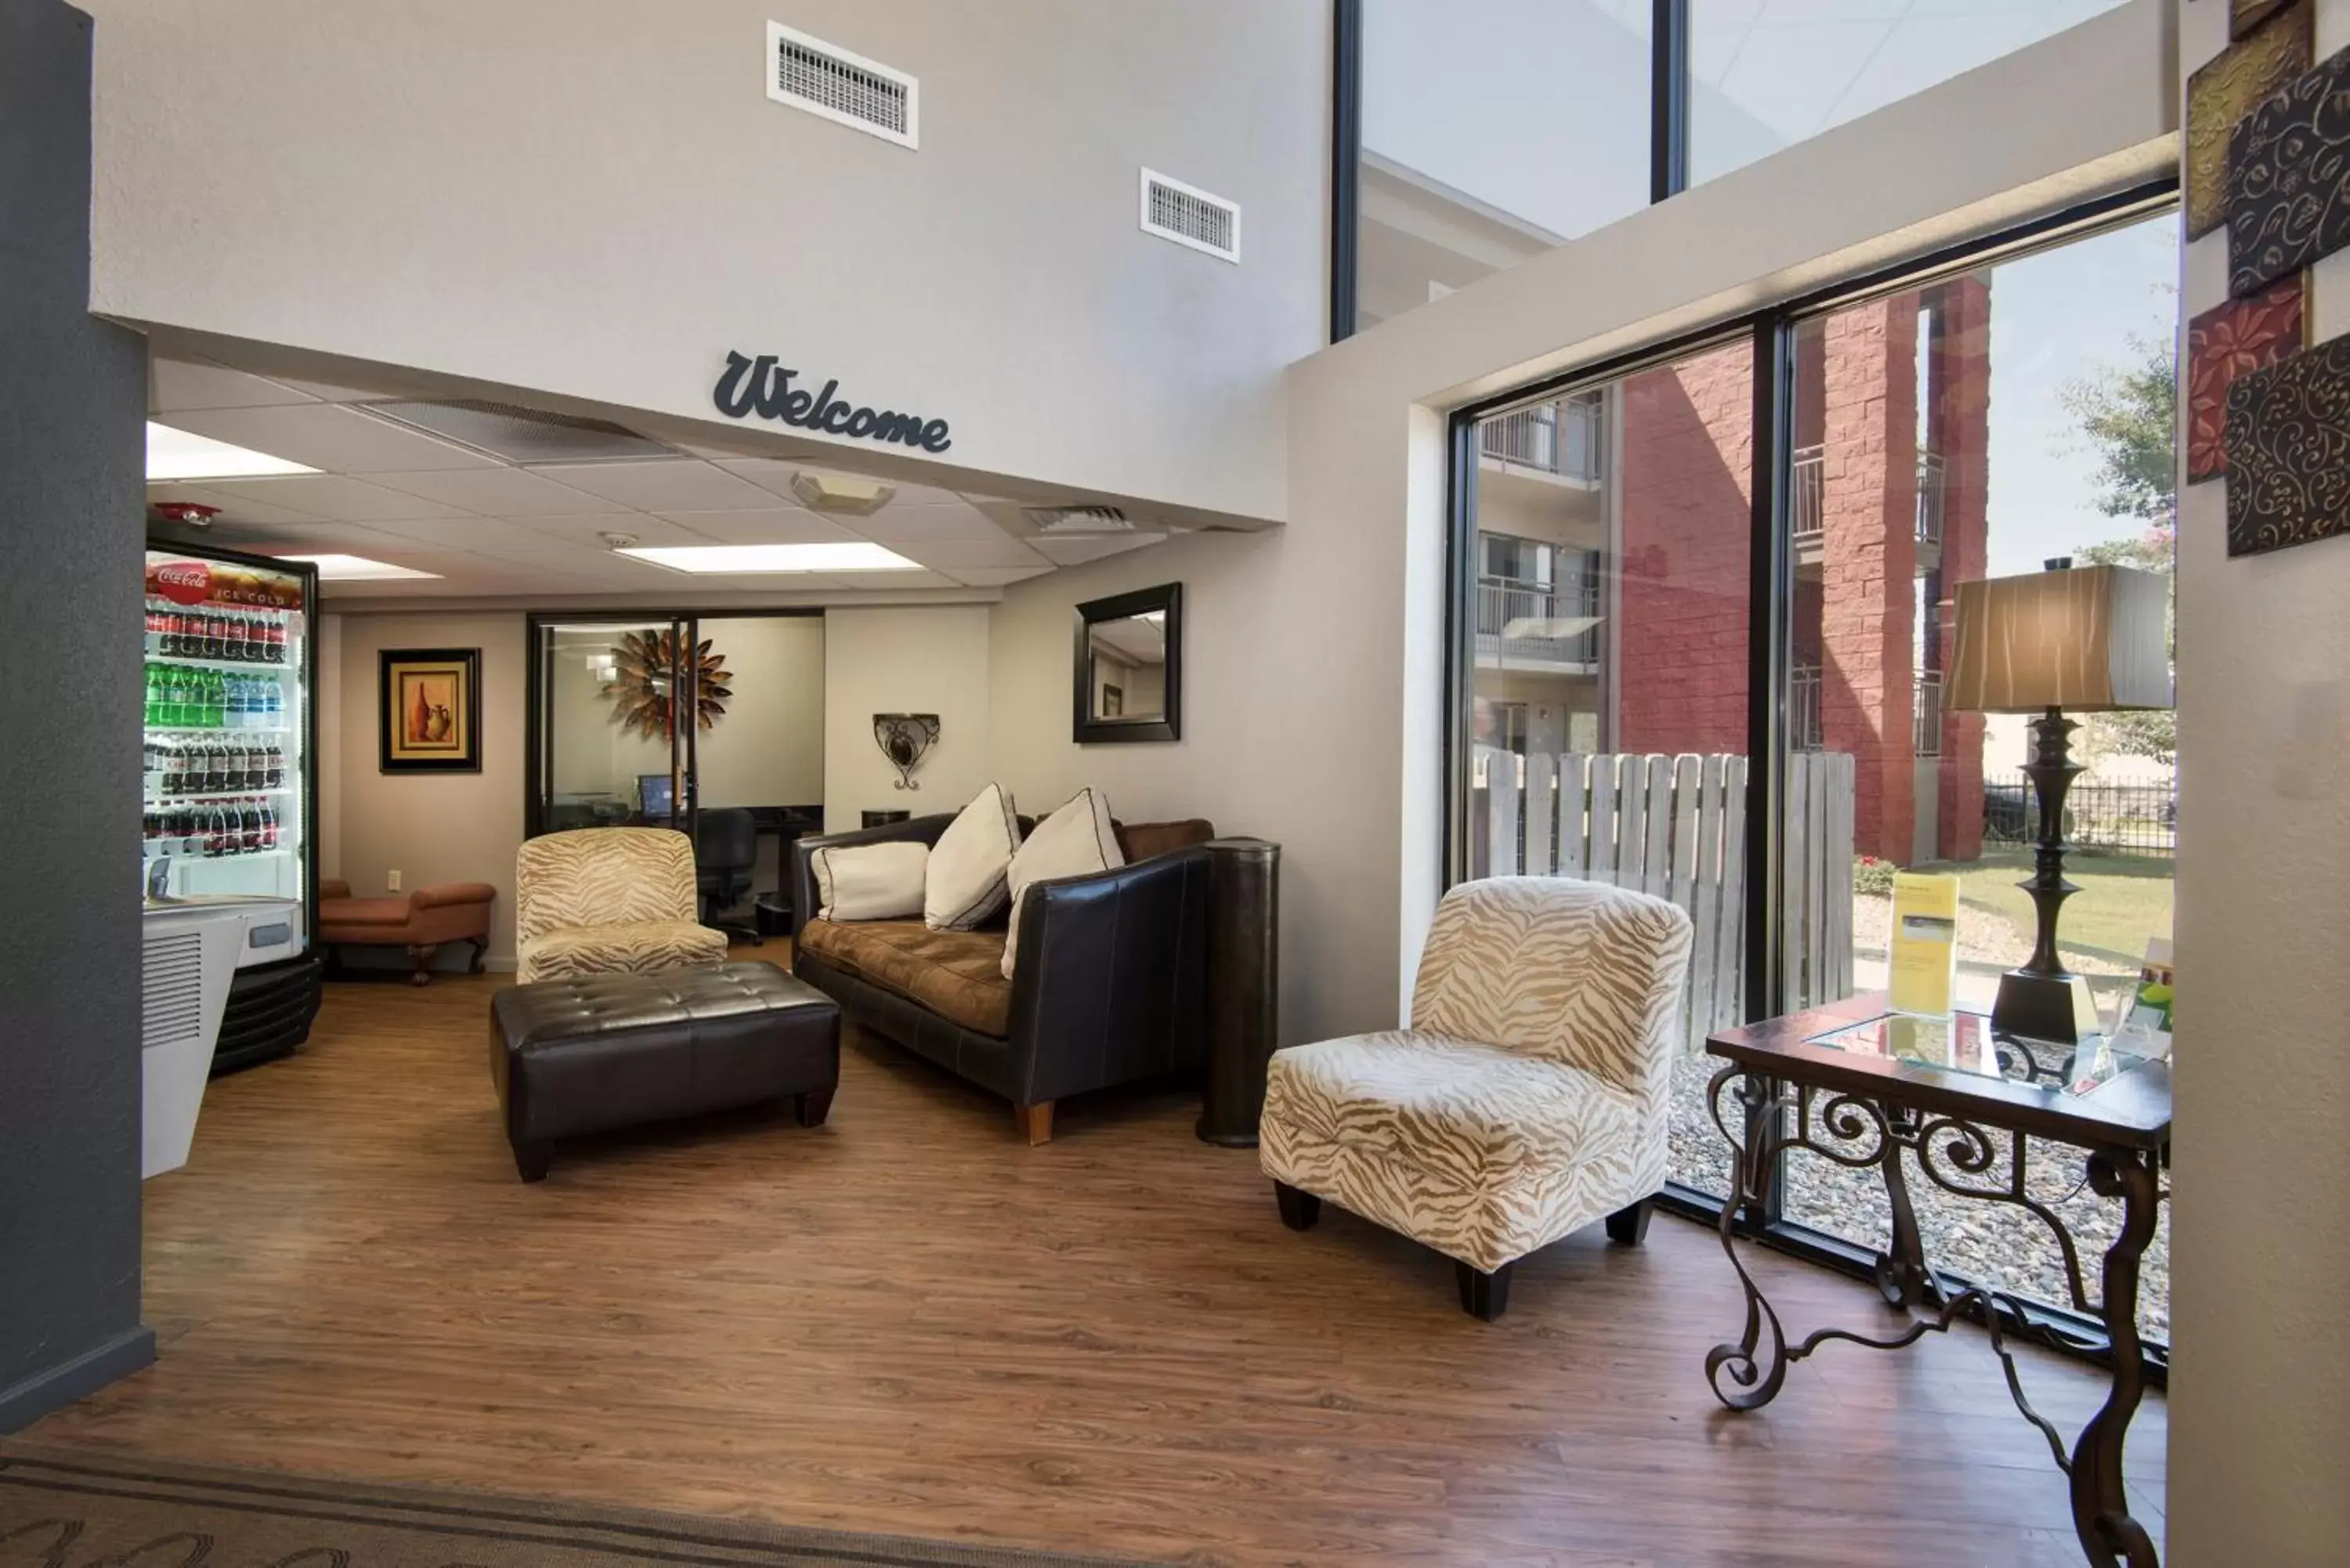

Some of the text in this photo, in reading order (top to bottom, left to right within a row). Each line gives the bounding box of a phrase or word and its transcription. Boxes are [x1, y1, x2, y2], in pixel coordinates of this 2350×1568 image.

[713, 349, 952, 453] Welcome
[216, 588, 285, 605] ICE COLD
